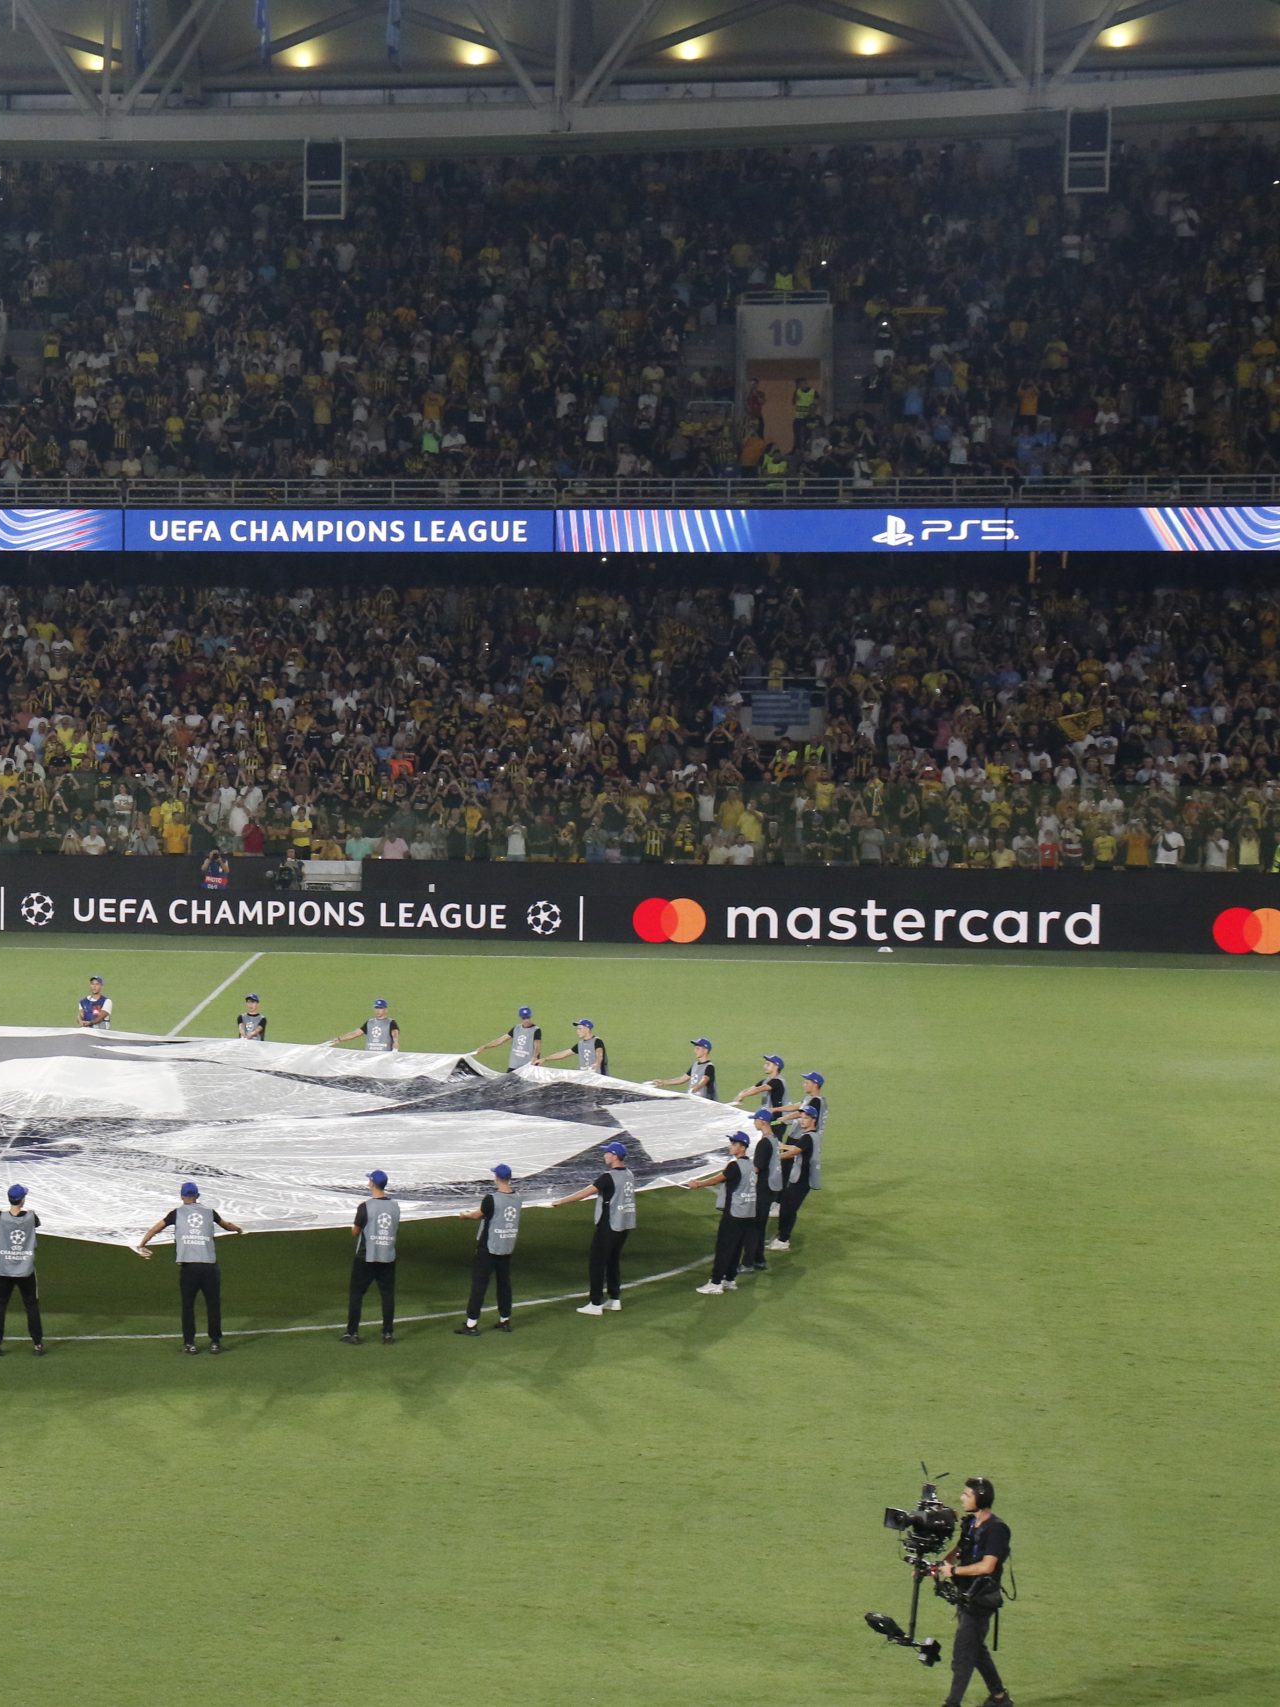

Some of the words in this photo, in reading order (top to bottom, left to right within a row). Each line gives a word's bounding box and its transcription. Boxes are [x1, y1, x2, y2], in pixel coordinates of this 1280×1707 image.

[769, 318, 804, 347] 10
[149, 519, 222, 542] UEFA
[229, 519, 406, 543] CHAMPIONS
[413, 520, 528, 543] LEAGUE
[73, 897, 159, 924] UEFA
[168, 898, 366, 927] CHAMPIONS
[379, 902, 507, 930] LEAGUE
[726, 899, 1101, 946] mastercard
